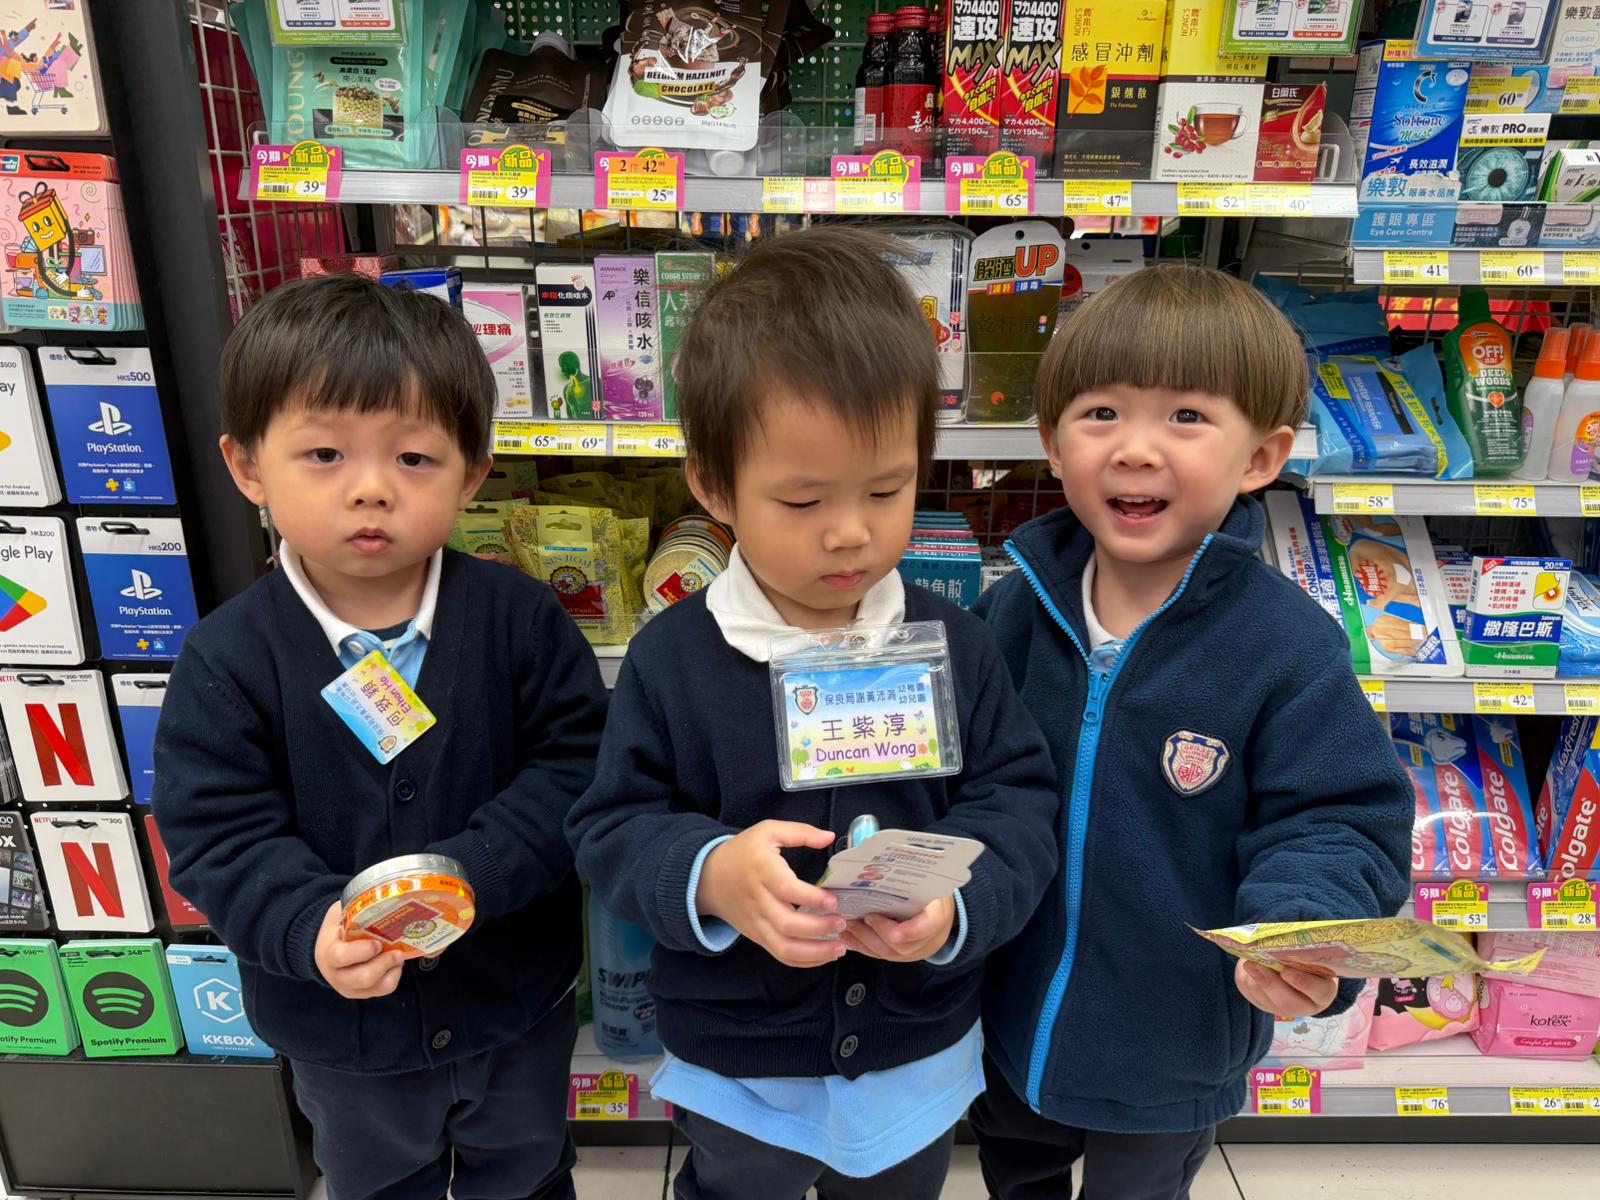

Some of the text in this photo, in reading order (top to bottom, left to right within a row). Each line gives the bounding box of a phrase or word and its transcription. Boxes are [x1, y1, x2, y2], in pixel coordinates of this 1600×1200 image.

[953, 16, 999, 42] 速攻
[1012, 16, 1057, 42] 速攻
[1071, 42, 1155, 63] 感冒沖劑
[948, 37, 1004, 84] MAX
[1004, 38, 1062, 84] MAX
[686, 68, 727, 81] HAZELNUT
[661, 83, 716, 94] CHOCOLATE
[1271, 87, 1300, 99] 白蘭氏
[1498, 92, 1516, 106] 60
[1399, 128, 1432, 142] Moist
[1502, 123, 1526, 134] PRO
[256, 146, 325, 165] 今期 新品
[465, 148, 534, 169] 今期 新品
[619, 159, 627, 172] 2
[642, 159, 658, 173] 42
[836, 157, 902, 176] 今期 新品
[950, 157, 1017, 176] 今期 新品
[1409, 158, 1448, 170] 長效滋潤
[302, 180, 320, 194] 39
[510, 186, 528, 199] 39
[1367, 177, 1408, 198] 樂敦
[651, 188, 667, 202] 25
[882, 191, 897, 204] 15
[1005, 195, 1022, 207] 65
[1106, 195, 1121, 208] 47
[1223, 196, 1239, 208] 52
[1371, 212, 1436, 227] 護眼專區
[1370, 228, 1433, 236] Eye Care Centre
[973, 243, 1060, 281] 解酒 UP
[1426, 265, 1441, 277] 41
[1517, 265, 1533, 277] 60
[633, 268, 653, 351] 樂信咳水
[1472, 345, 1504, 360] OFF!
[117, 372, 151, 383] HK$500
[1480, 368, 1507, 377] DEEP
[1475, 377, 1511, 386] WOODS
[0, 382, 16, 396] ay
[87, 442, 142, 455] PlayStation
[534, 436, 550, 448] 65
[582, 437, 598, 449] 69
[654, 438, 669, 449] 48
[1368, 496, 1384, 508] 58
[1514, 497, 1528, 508] 75
[24, 545, 54, 562] Play
[148, 542, 182, 552] HK$200
[1337, 555, 1354, 606] Hisamitsu
[119, 606, 173, 617] PlayStation
[1482, 620, 1553, 638] 撒隆巴斯
[380, 676, 411, 714] Ethan Ho
[898, 694, 926, 704] 幼兒園
[1513, 694, 1527, 706] 42
[821, 712, 907, 742] 王紫淳
[816, 742, 917, 762] Duncan Wong
[1445, 771, 1472, 871] Colgate
[1490, 771, 1519, 871] Colgate
[1419, 885, 1474, 900] 今期 新品
[1532, 883, 1586, 899] 今期 新品
[1468, 914, 1481, 924] 53
[1578, 913, 1591, 924] 28
[1529, 1015, 1568, 1027] kotex
[20, 1035, 57, 1045] Premium
[90, 1037, 124, 1048] Spotify
[125, 1036, 167, 1045] Premium
[202, 1034, 255, 1047] KKBOX
[1256, 1067, 1307, 1084] 今期 新品
[610, 1103, 623, 1113] 35
[1291, 1098, 1305, 1109] 50
[1431, 1098, 1445, 1110] 76
[1544, 1097, 1557, 1108] 26
